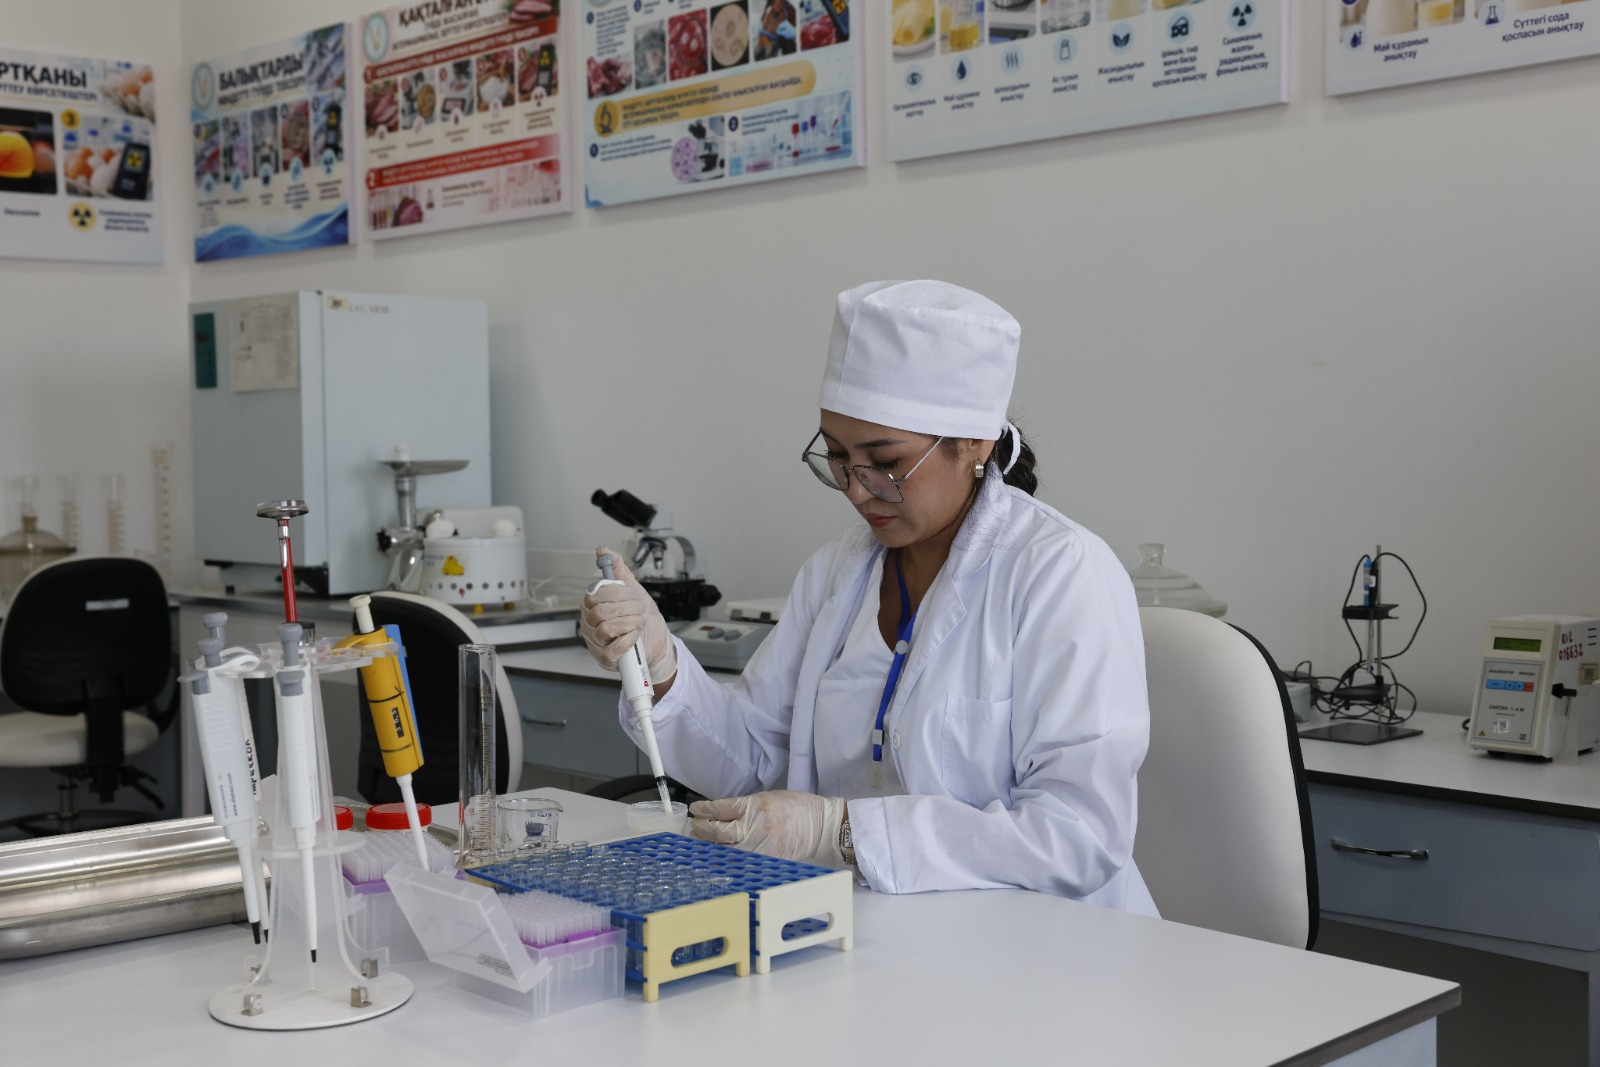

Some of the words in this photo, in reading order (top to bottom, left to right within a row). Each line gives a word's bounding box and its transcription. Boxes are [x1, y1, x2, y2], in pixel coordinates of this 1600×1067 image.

[1513, 15, 1546, 30] Сүттегі
[1547, 11, 1570, 24] сода
[1502, 28, 1545, 43] қоспасын
[1546, 20, 1585, 37] анықтау
[1373, 40, 1391, 53] Май
